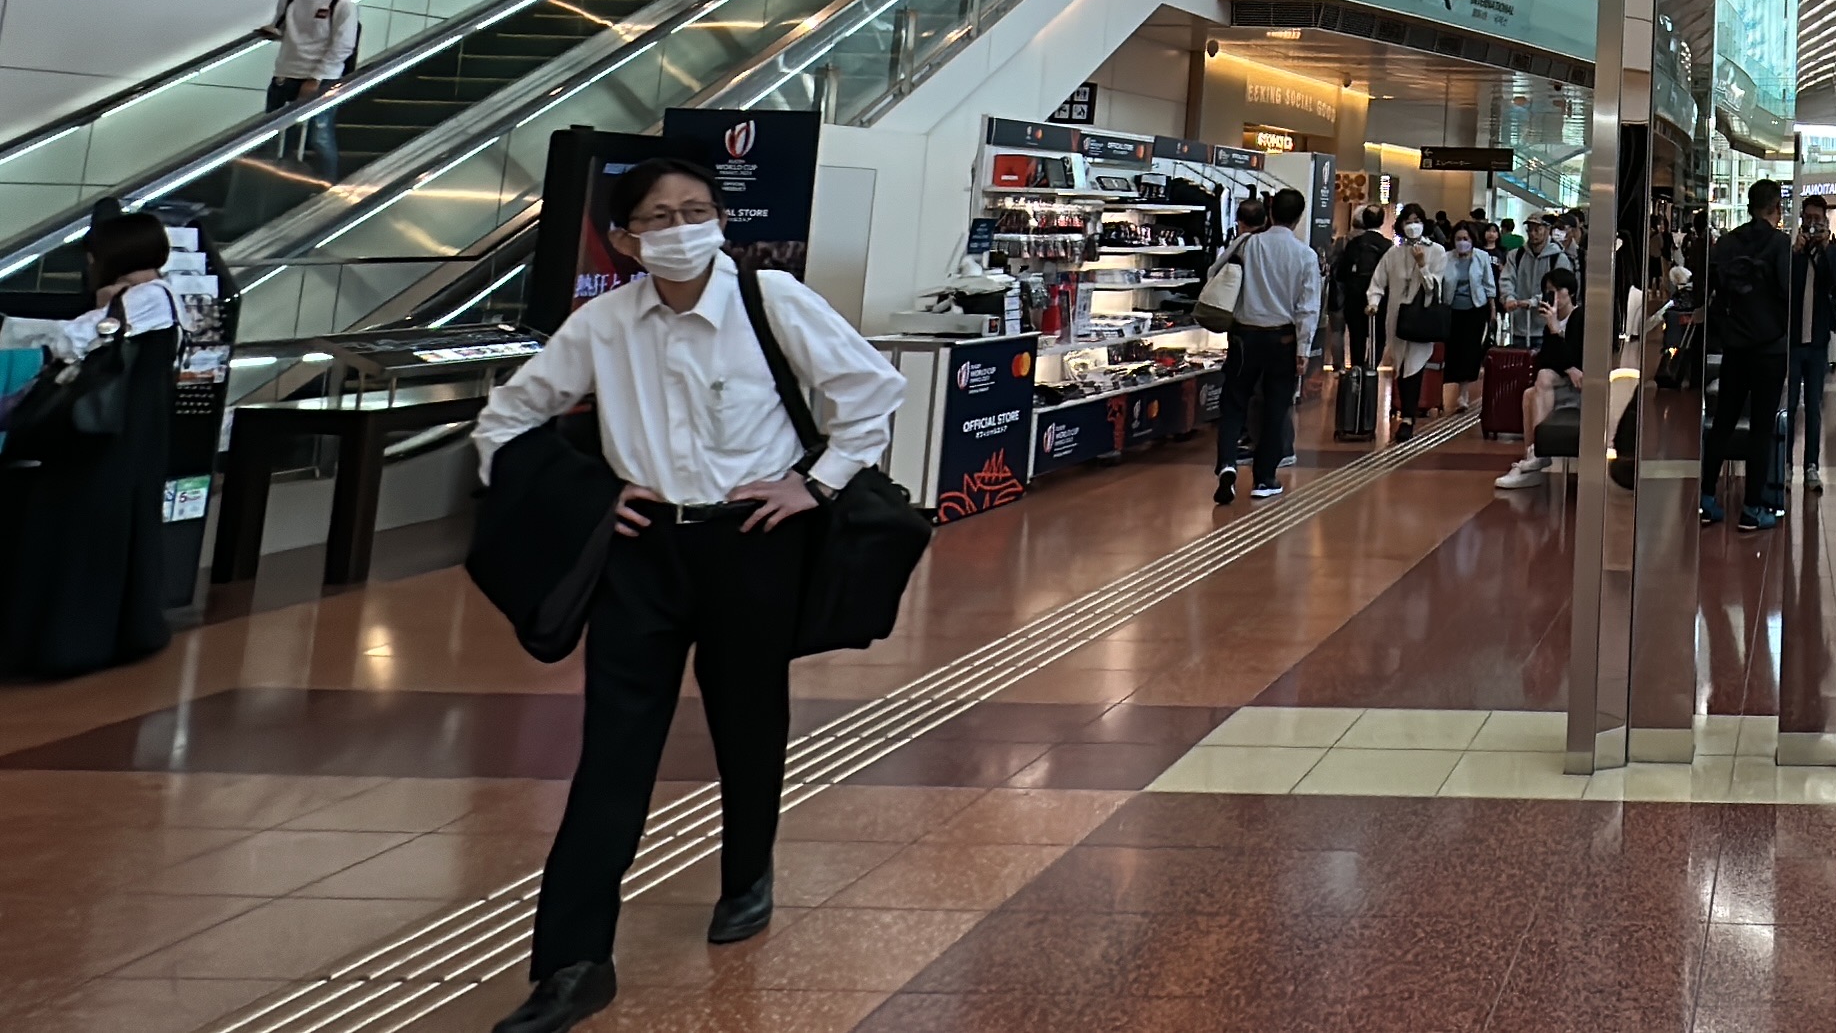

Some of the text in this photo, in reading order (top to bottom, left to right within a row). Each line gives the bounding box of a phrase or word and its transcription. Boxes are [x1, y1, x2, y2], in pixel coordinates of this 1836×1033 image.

[1246, 84, 1282, 105] EEKING
[738, 208, 769, 217] STORE
[962, 409, 1021, 433] OFFICIAL STORE
